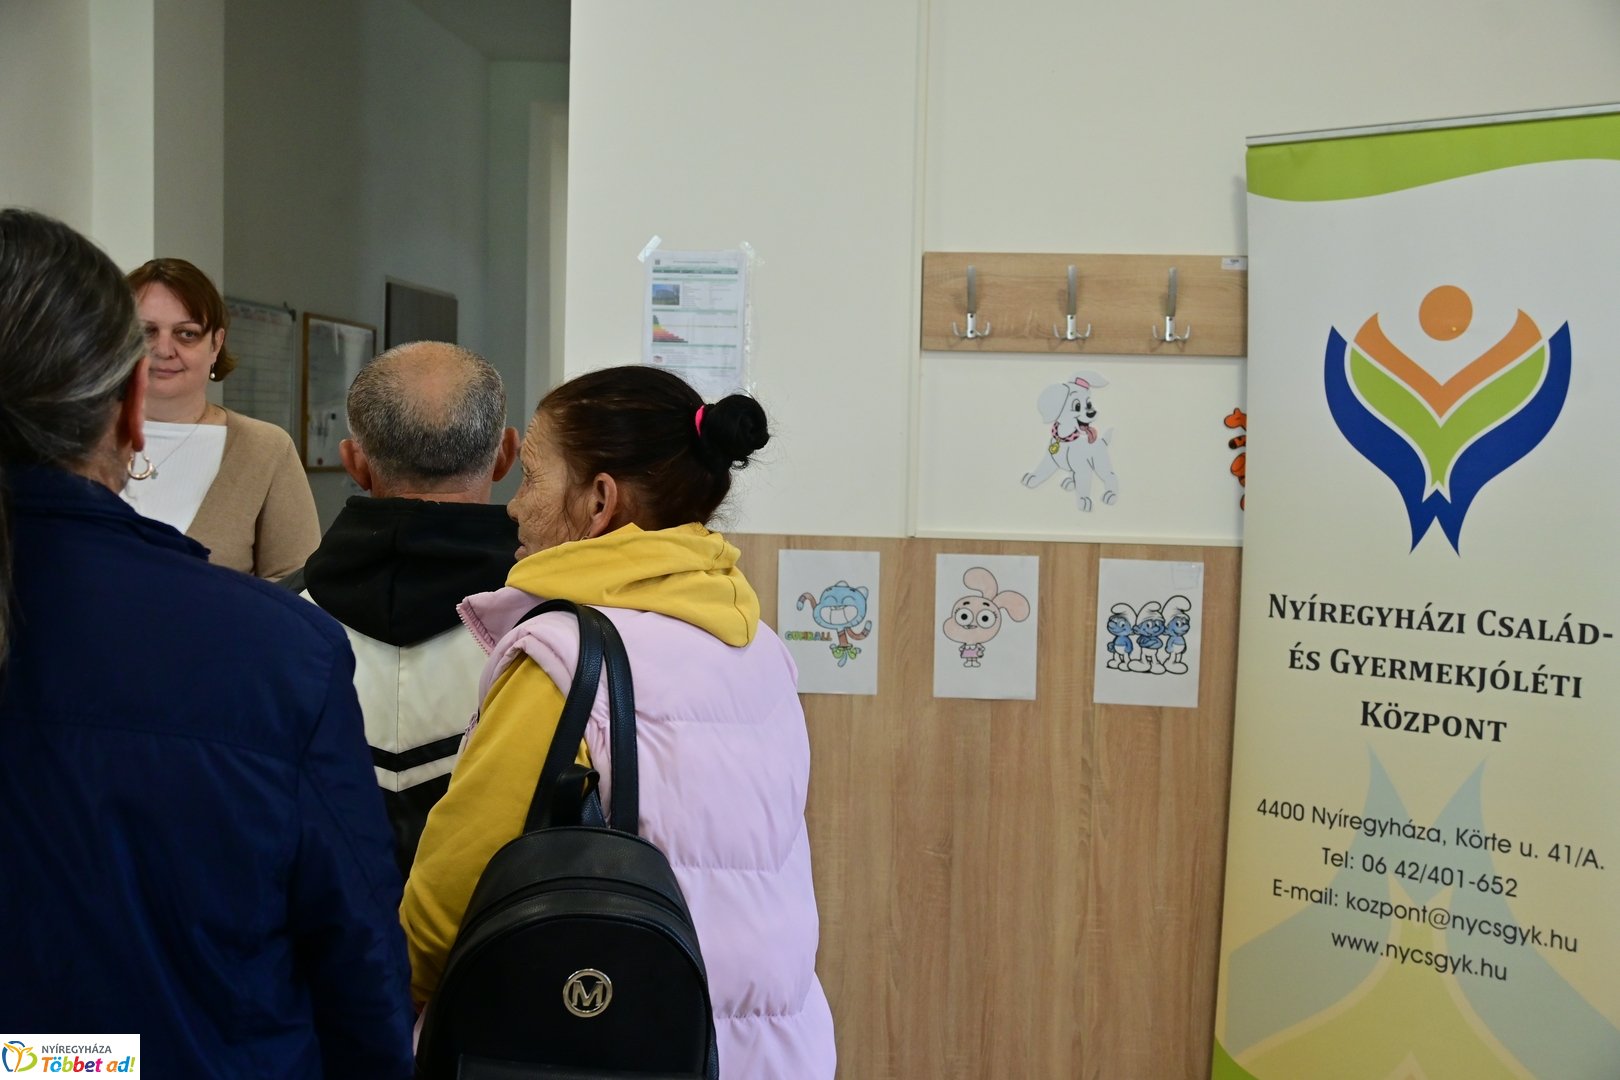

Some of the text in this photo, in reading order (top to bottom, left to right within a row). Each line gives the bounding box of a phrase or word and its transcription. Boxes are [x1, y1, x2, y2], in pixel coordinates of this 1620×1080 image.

[1256, 798, 1604, 870] 4400 Nyíregyháza, Körte u. 41/A.
[1321, 846, 1518, 898] Tel: 06 42/401-652
[1272, 878, 1578, 953] E-mail: kozpont@nycsgyk.hu
[1331, 932, 1507, 982] www.nycsgyk.hu
[571, 980, 604, 1006] M
